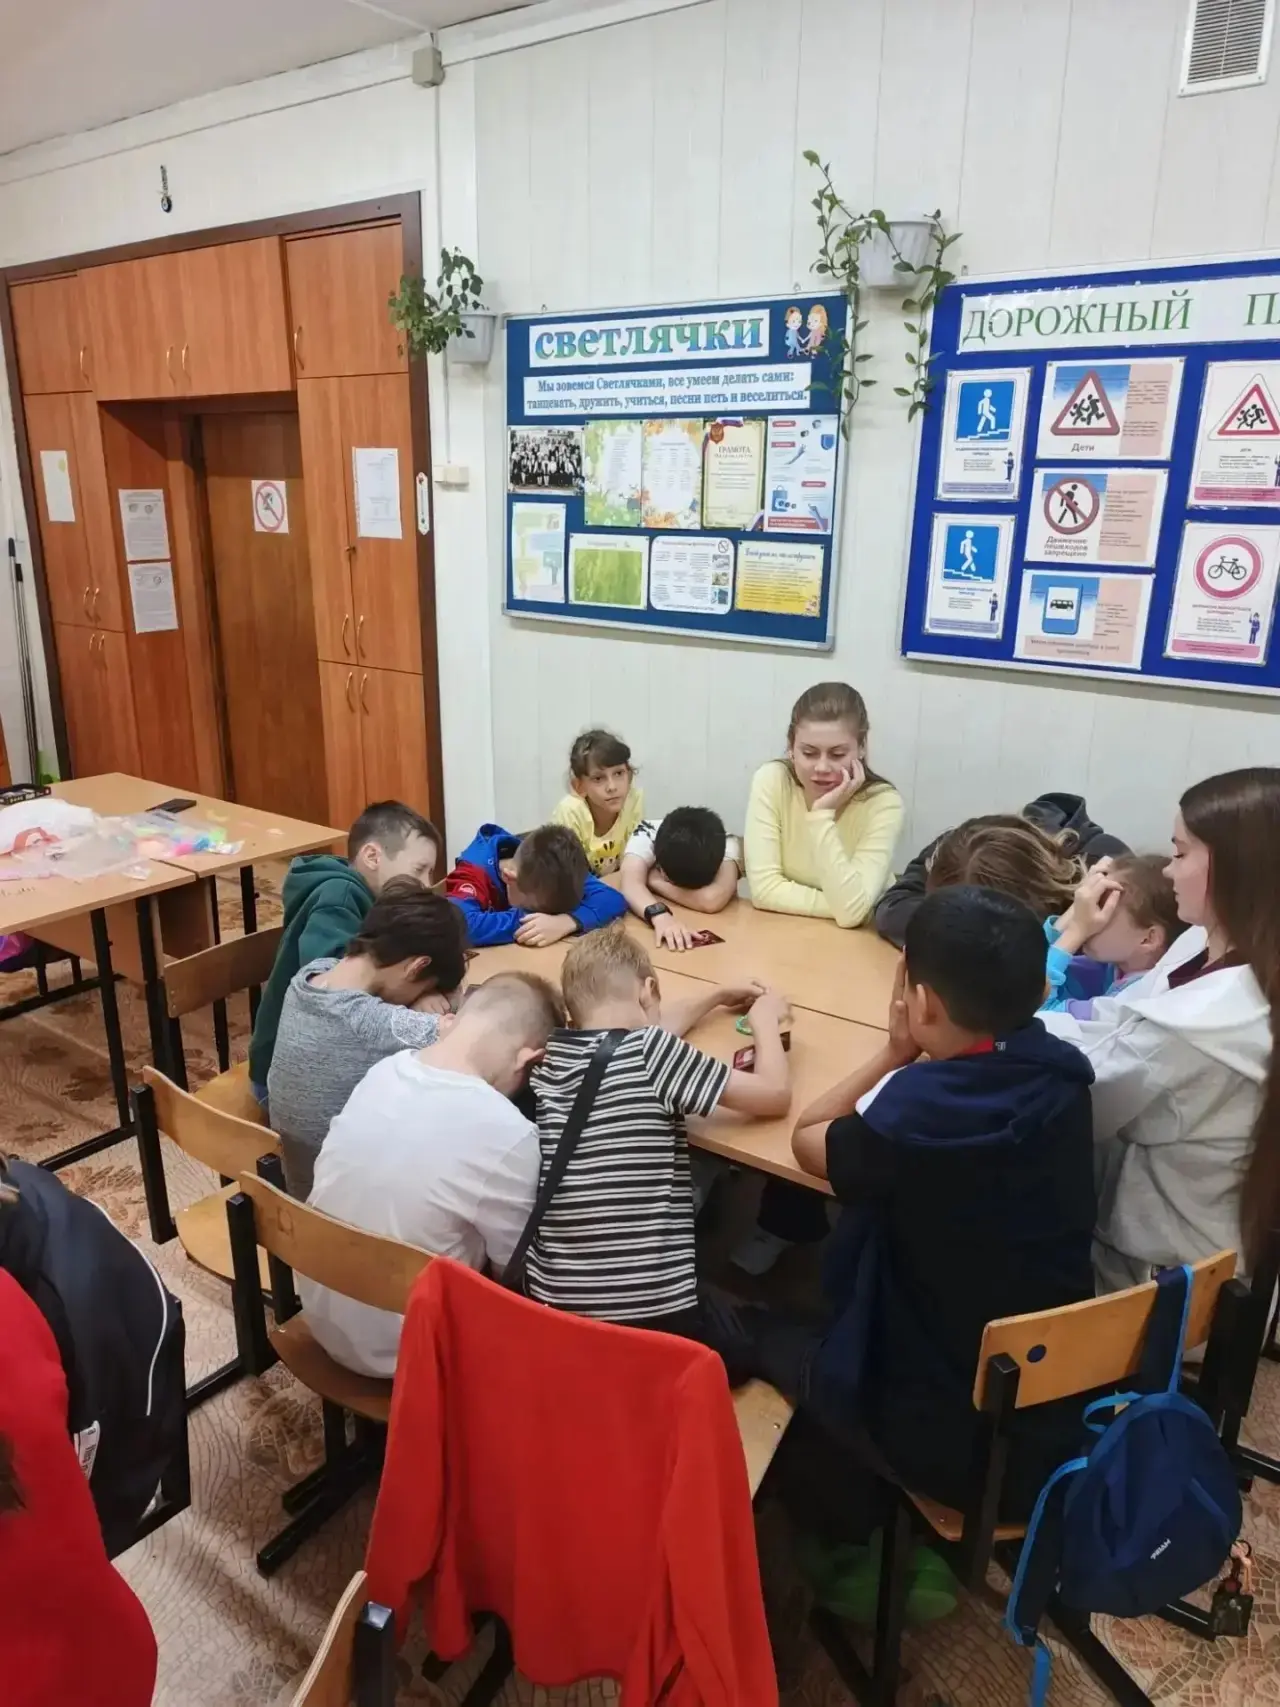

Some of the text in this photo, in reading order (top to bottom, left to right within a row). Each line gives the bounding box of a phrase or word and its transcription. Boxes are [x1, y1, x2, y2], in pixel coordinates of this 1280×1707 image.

[962, 289, 1280, 345] ДОРОЖНЫЙ П
[538, 371, 795, 392] Мы зовемся Светлячками, все умеем делать сами:
[527, 390, 807, 411] танцевать, дружить, учиться, песни петь и веселиться.
[718, 446, 751, 454] ГРАМОТА
[1070, 442, 1095, 453] Дети
[1046, 536, 1088, 544] Движение
